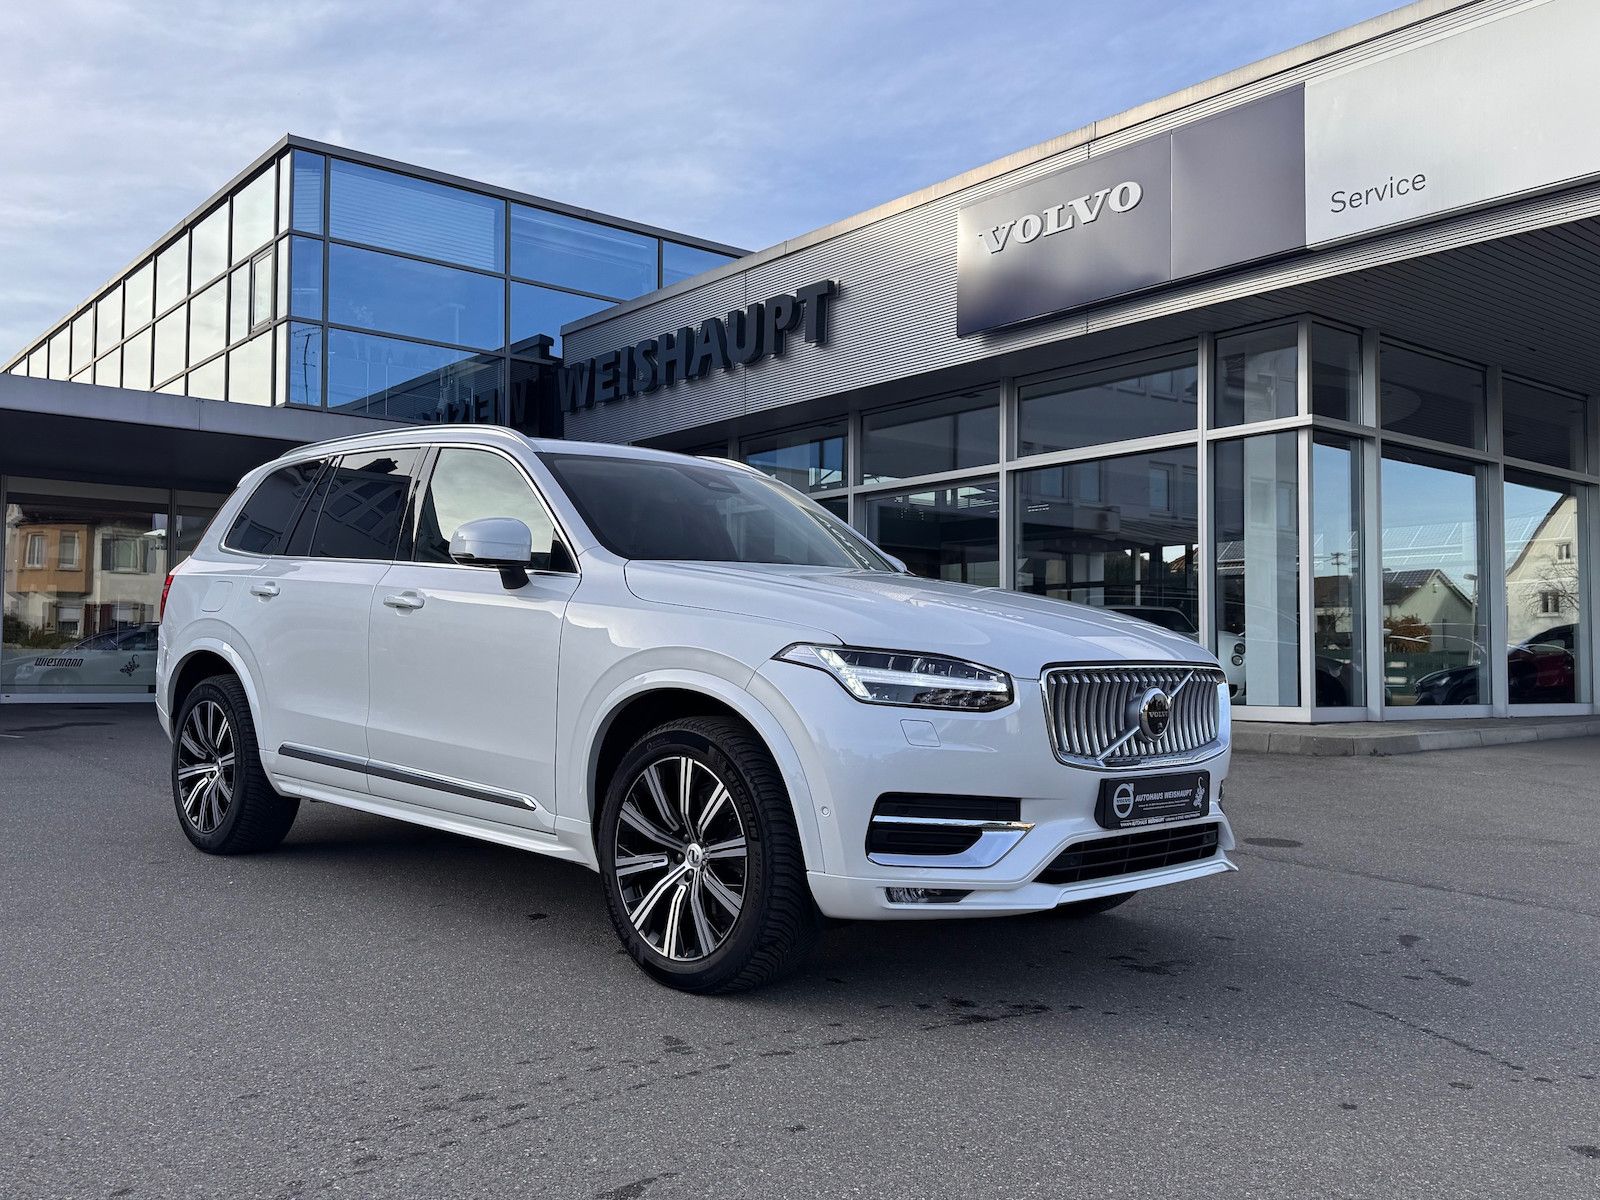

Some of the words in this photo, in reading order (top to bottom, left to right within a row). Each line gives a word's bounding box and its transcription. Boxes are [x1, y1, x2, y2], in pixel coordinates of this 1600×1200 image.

[978, 181, 1143, 254] VOLVO
[1330, 171, 1427, 213] Service
[557, 279, 838, 413] WEISHAUPT
[1135, 792, 1163, 802] AUTOHAUS
[1164, 789, 1193, 799] WEISHAUPT
